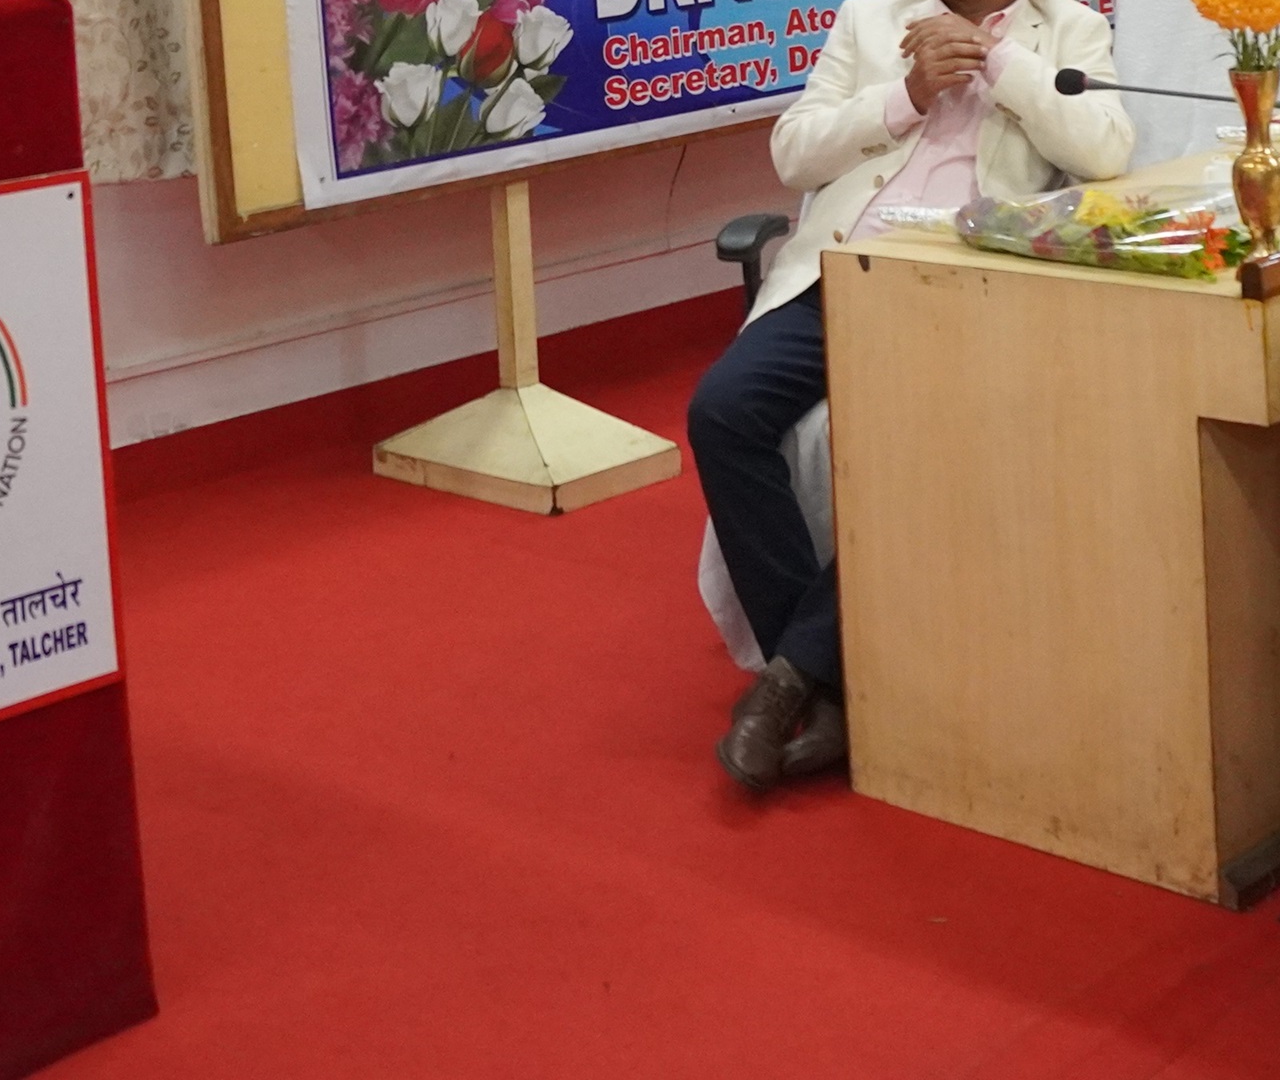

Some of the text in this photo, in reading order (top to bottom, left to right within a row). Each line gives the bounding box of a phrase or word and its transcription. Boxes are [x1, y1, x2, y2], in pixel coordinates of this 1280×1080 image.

[604, 19, 775, 66] Chairman,
[605, 59, 778, 107] Secretary,
[0, 571, 83, 626] तालचेर
[8, 621, 89, 669] TALCHER
